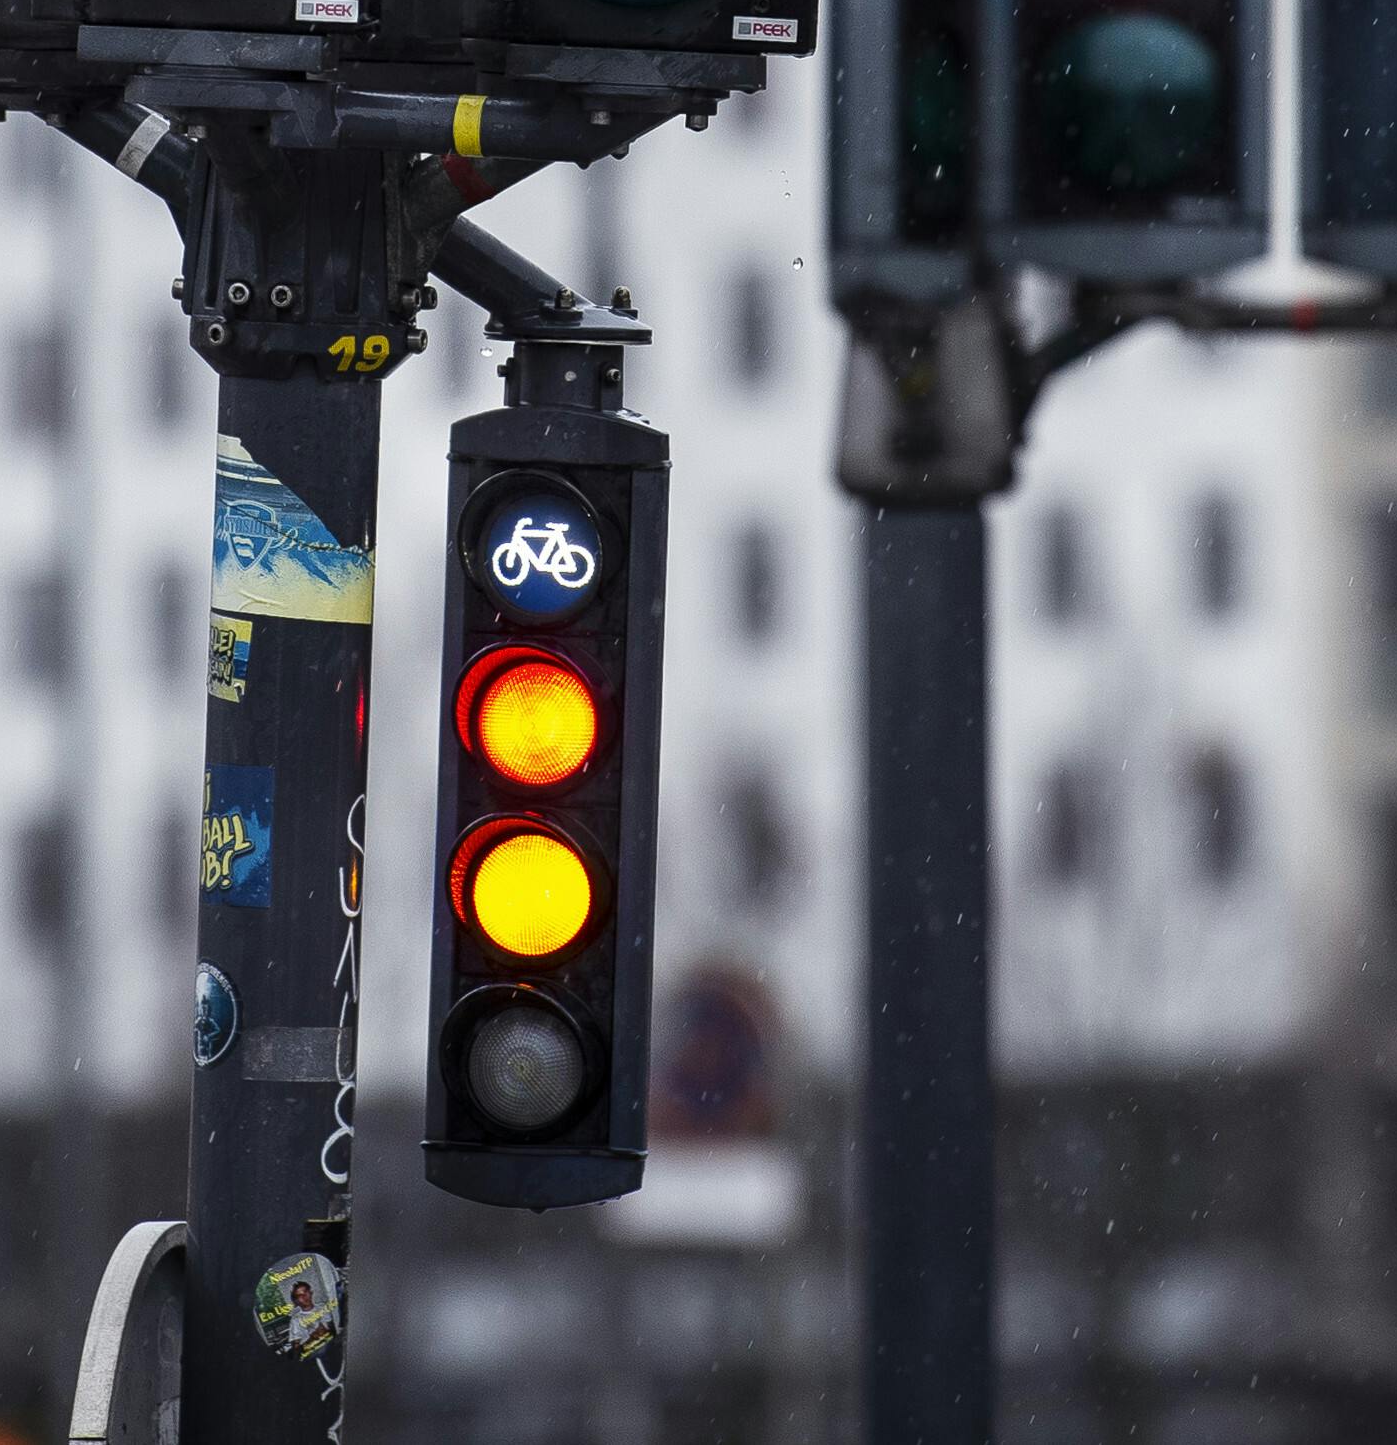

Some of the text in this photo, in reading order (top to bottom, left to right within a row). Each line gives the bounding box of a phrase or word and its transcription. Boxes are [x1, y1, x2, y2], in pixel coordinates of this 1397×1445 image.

[315, 3, 353, 17] PEEK
[753, 23, 792, 37] PEEK
[328, 336, 390, 371] 19
